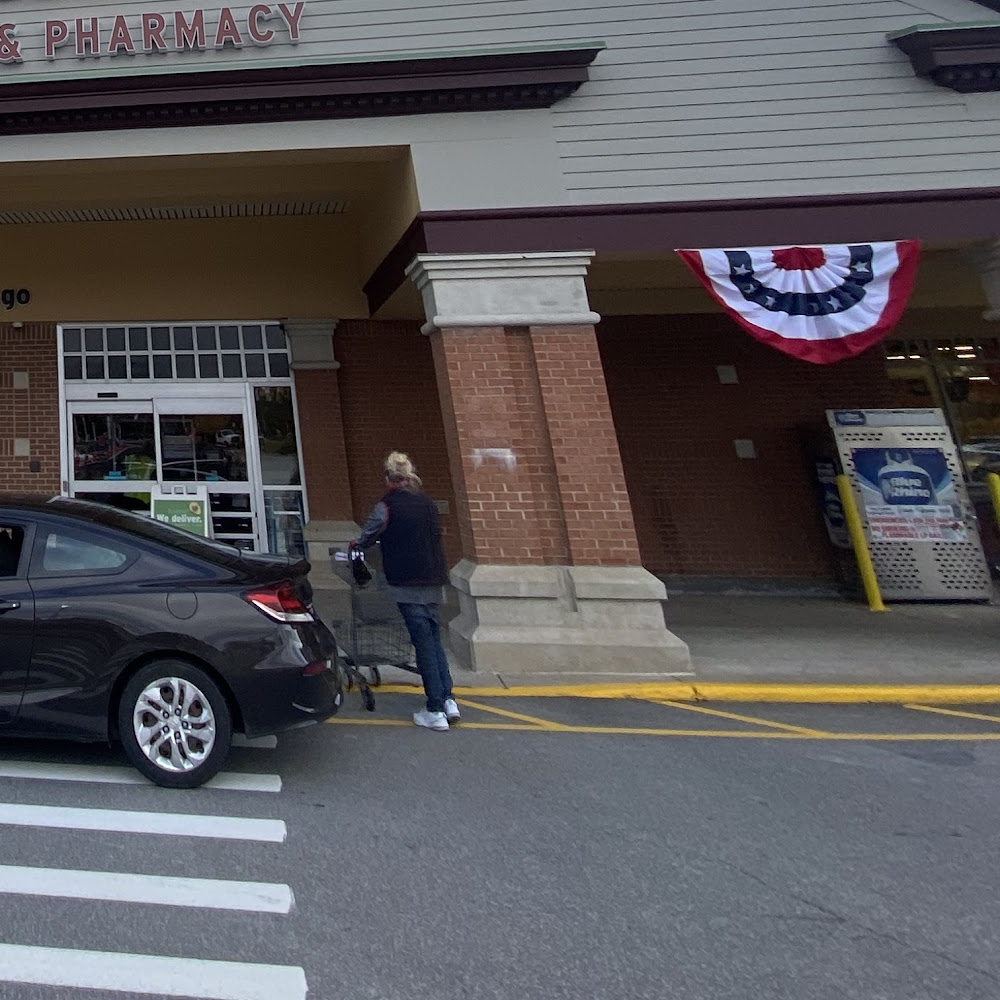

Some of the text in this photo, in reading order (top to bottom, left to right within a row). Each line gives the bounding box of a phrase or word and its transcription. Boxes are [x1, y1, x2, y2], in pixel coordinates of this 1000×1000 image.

[45, 2, 305, 57] PHARMACY
[1, 287, 31, 310] go
[156, 513, 203, 523] We deliver.
